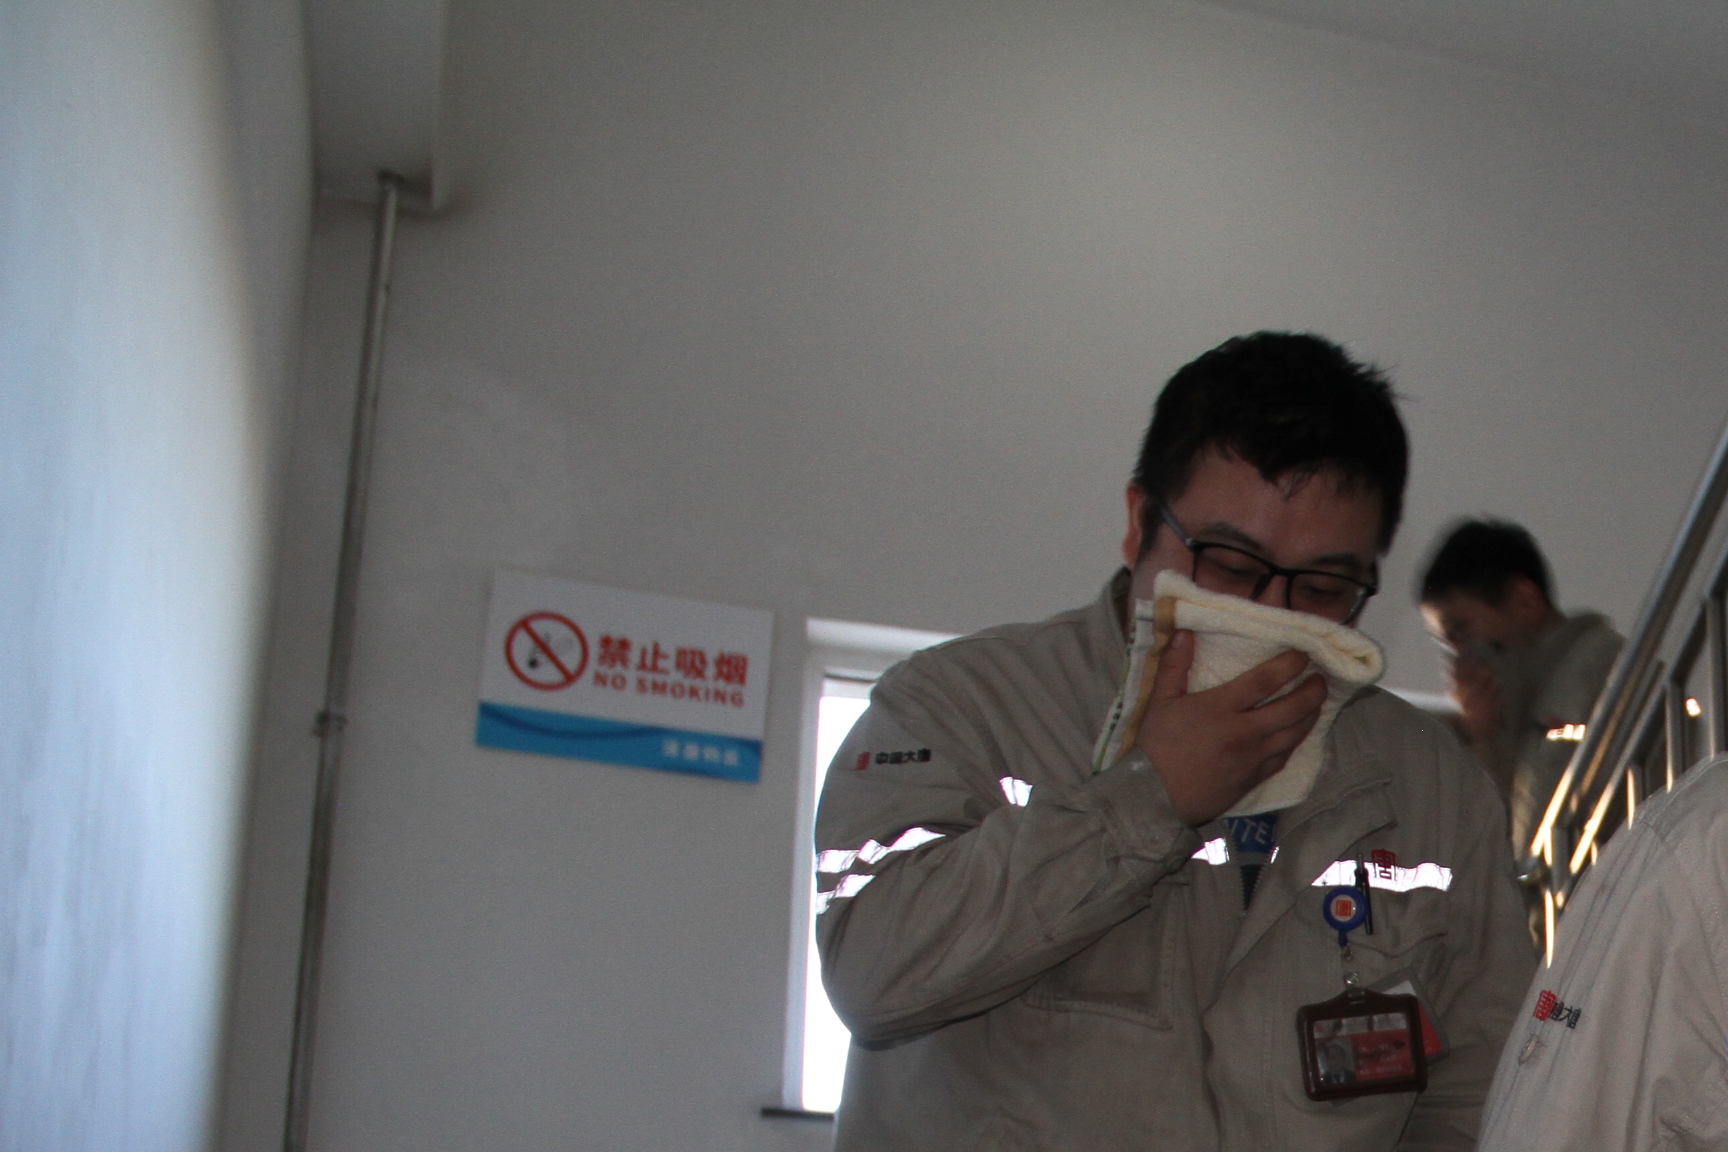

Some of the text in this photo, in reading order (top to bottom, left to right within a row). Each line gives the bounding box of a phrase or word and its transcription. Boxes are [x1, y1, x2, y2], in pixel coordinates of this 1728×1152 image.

[597, 634, 749, 687] 禁止吸烟
[594, 671, 746, 708] NO SMOKING
